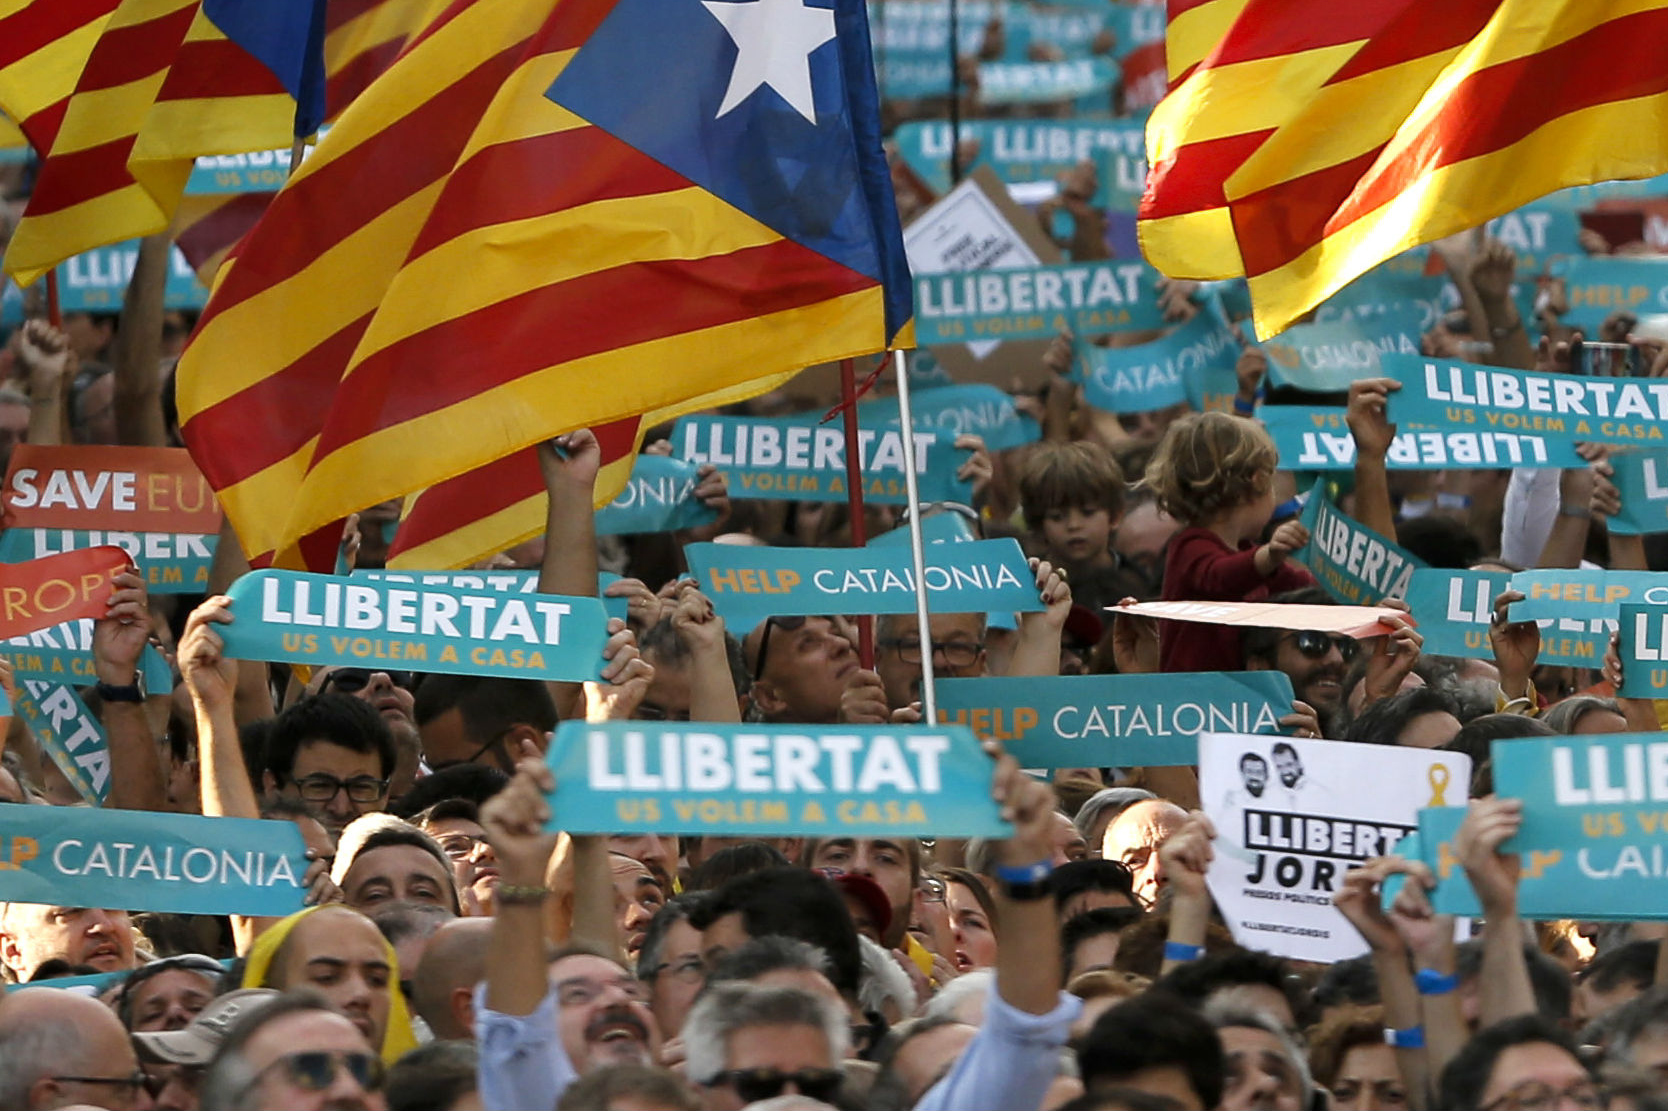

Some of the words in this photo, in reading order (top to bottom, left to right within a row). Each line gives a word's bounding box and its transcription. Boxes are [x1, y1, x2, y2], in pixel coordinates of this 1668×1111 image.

[917, 264, 1144, 318] LLIBERTAT
[1571, 284, 1648, 308] HELP
[937, 319, 965, 337] US
[973, 316, 1045, 335] VOLEM
[1077, 309, 1132, 329] CASA
[1446, 406, 1476, 425] US
[1485, 411, 1564, 434] VOLEM
[1575, 418, 1592, 435] A
[1602, 421, 1664, 440] CASA
[10, 468, 137, 512] SAVE
[741, 471, 818, 494] VOLEM
[828, 475, 845, 494] A
[1314, 508, 1415, 601] LLIBERTA
[710, 567, 801, 594] HELP
[1530, 584, 1630, 604] HELP
[262, 577, 571, 647] LLIBERTAT
[52, 655, 64, 674] A
[281, 632, 318, 655] US
[332, 636, 429, 664] VOLEM
[439, 644, 459, 665] A
[470, 646, 547, 670] CASA
[937, 707, 1039, 741] HELP
[1052, 701, 1280, 739] CATALONIA
[587, 731, 949, 793] LLIBERTAT
[615, 798, 664, 824] US
[678, 799, 790, 824] VOLEM
[803, 800, 827, 824] A
[836, 800, 927, 825] CASA
[1582, 812, 1625, 838] US
[52, 839, 299, 888] CATALONIA
